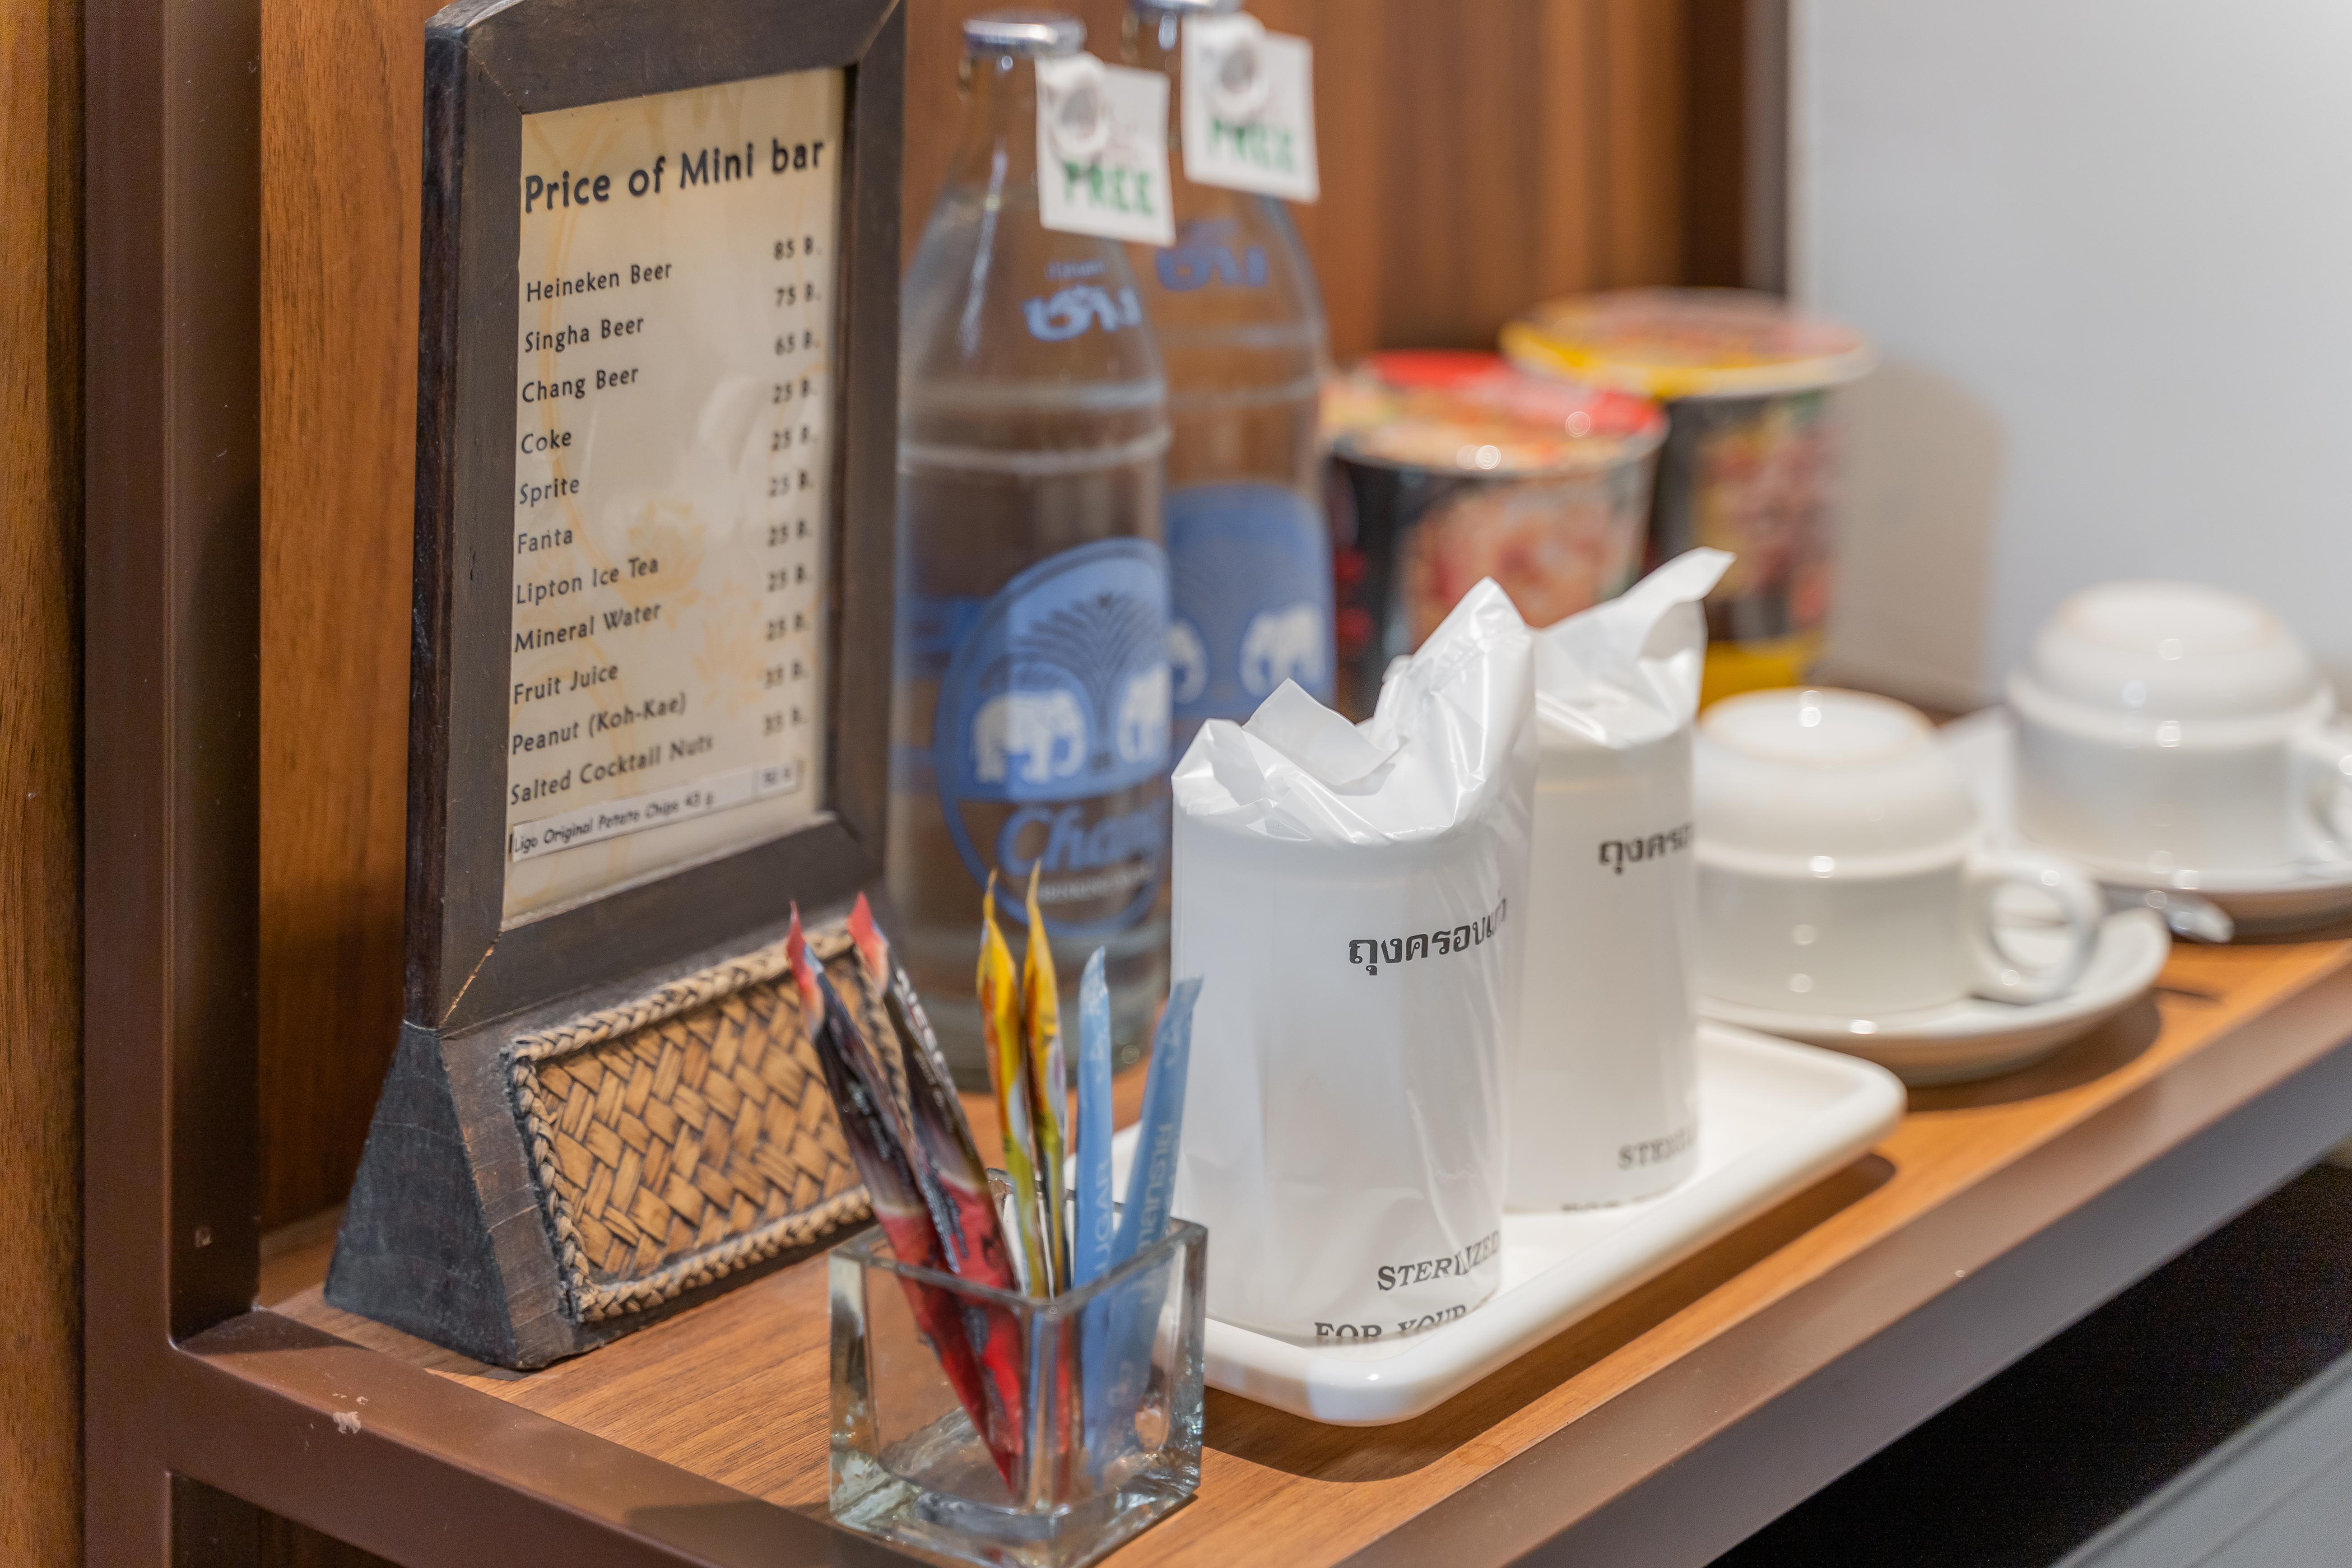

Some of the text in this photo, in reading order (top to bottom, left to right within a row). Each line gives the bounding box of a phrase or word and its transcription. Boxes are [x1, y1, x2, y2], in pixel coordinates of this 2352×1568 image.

[525, 138, 824, 213] Price of Mini bar
[526, 270, 620, 302] Heineken
[630, 262, 673, 285] Beer
[774, 238, 795, 261] 85
[525, 324, 590, 353] Singha
[601, 317, 644, 340] Beer
[776, 285, 796, 308] 75
[521, 376, 586, 403] Chang
[596, 366, 639, 390] Beer
[774, 333, 795, 356] 65
[521, 429, 572, 454] Coke
[772, 381, 793, 405] 25
[519, 476, 580, 507] Sprite
[772, 427, 792, 451] 25
[517, 527, 574, 554] Fanta
[769, 475, 790, 498] 25
[516, 575, 582, 606] Lipton
[592, 565, 619, 587] Ice
[628, 556, 659, 578] Tea
[769, 522, 789, 547] 25
[514, 615, 595, 653] Mineral
[603, 603, 662, 630] Water
[768, 569, 788, 593] 25
[514, 678, 561, 704] Fruit
[570, 663, 618, 691] Juice
[512, 721, 579, 755] Peanut
[588, 691, 687, 740] (Koh-Kae)
[511, 769, 572, 805] Salted
[580, 746, 661, 785] Cocktail
[669, 734, 714, 761] Nuts
[543, 817, 594, 844] Original
[597, 810, 641, 830] Potato
[644, 800, 679, 819] Chips
